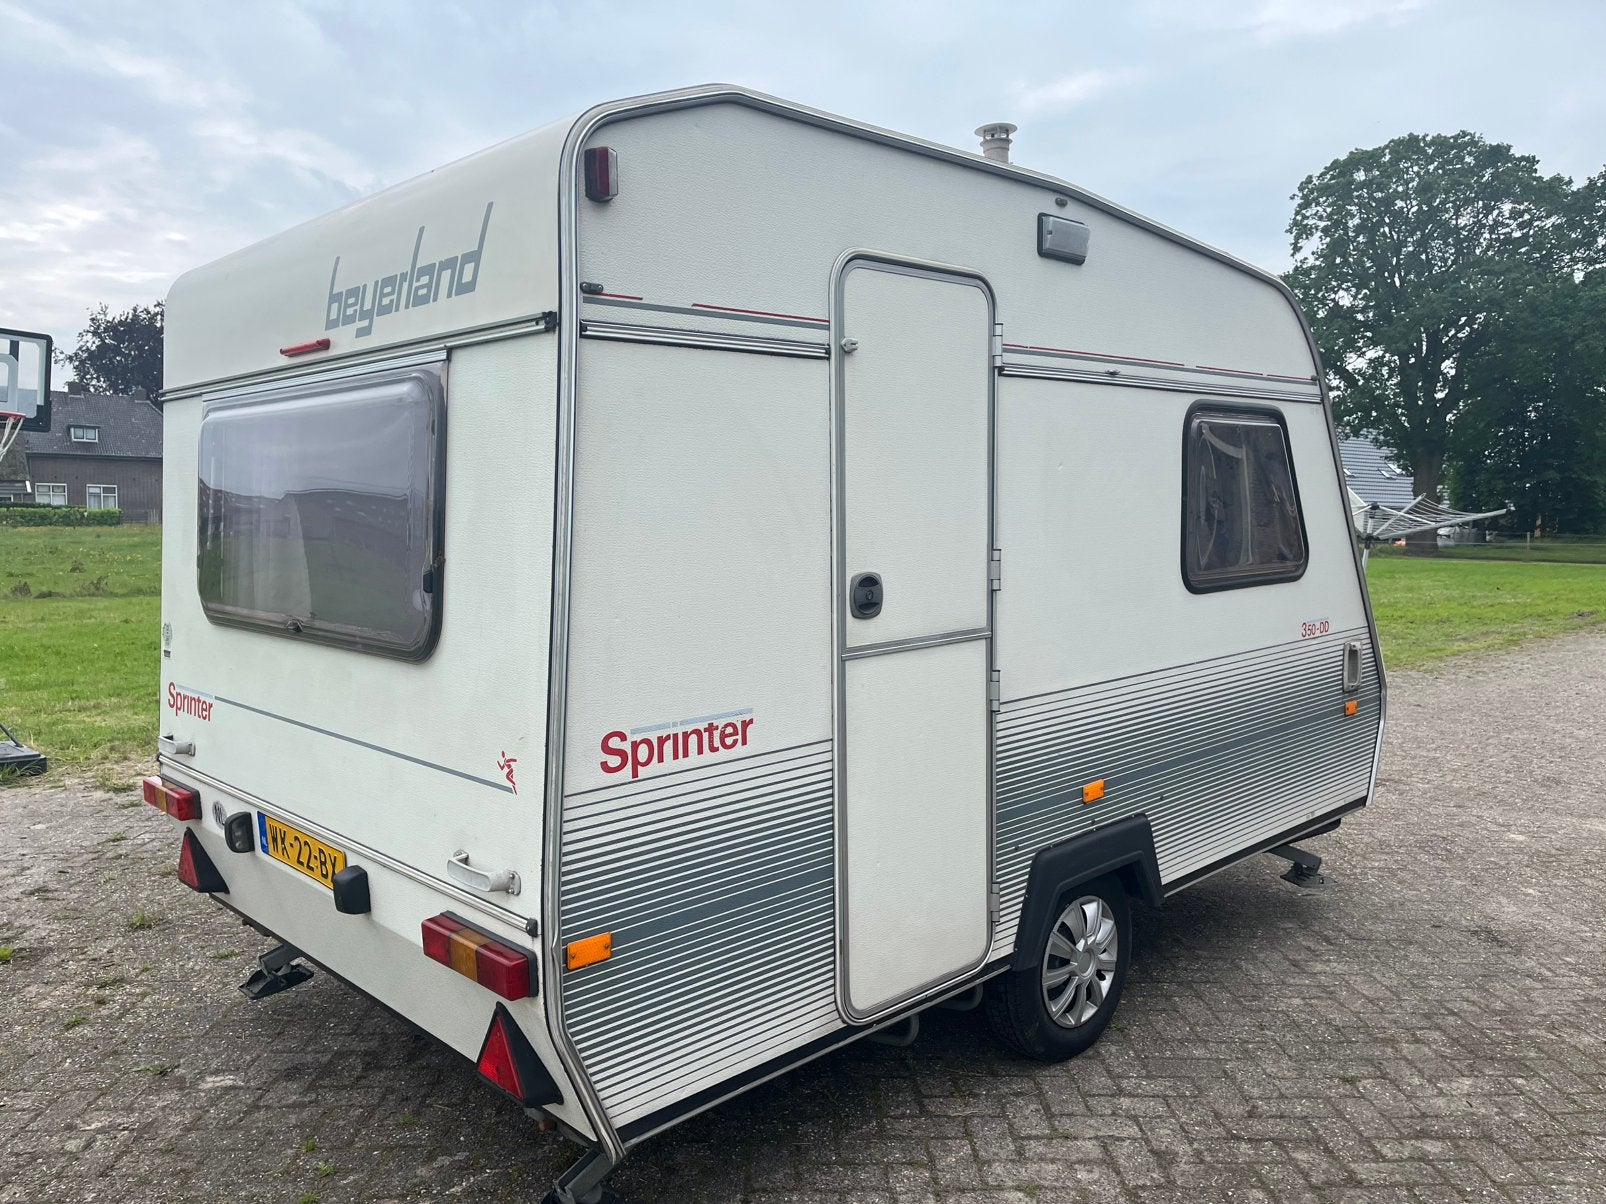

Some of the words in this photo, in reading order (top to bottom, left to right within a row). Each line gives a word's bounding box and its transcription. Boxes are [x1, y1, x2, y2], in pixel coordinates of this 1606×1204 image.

[325, 201, 493, 338] beyerland
[1301, 620, 1330, 638] 350-DD
[168, 681, 213, 722] Sprinter
[600, 718, 754, 779] Sprinter
[269, 823, 337, 883] WK-22-BY
